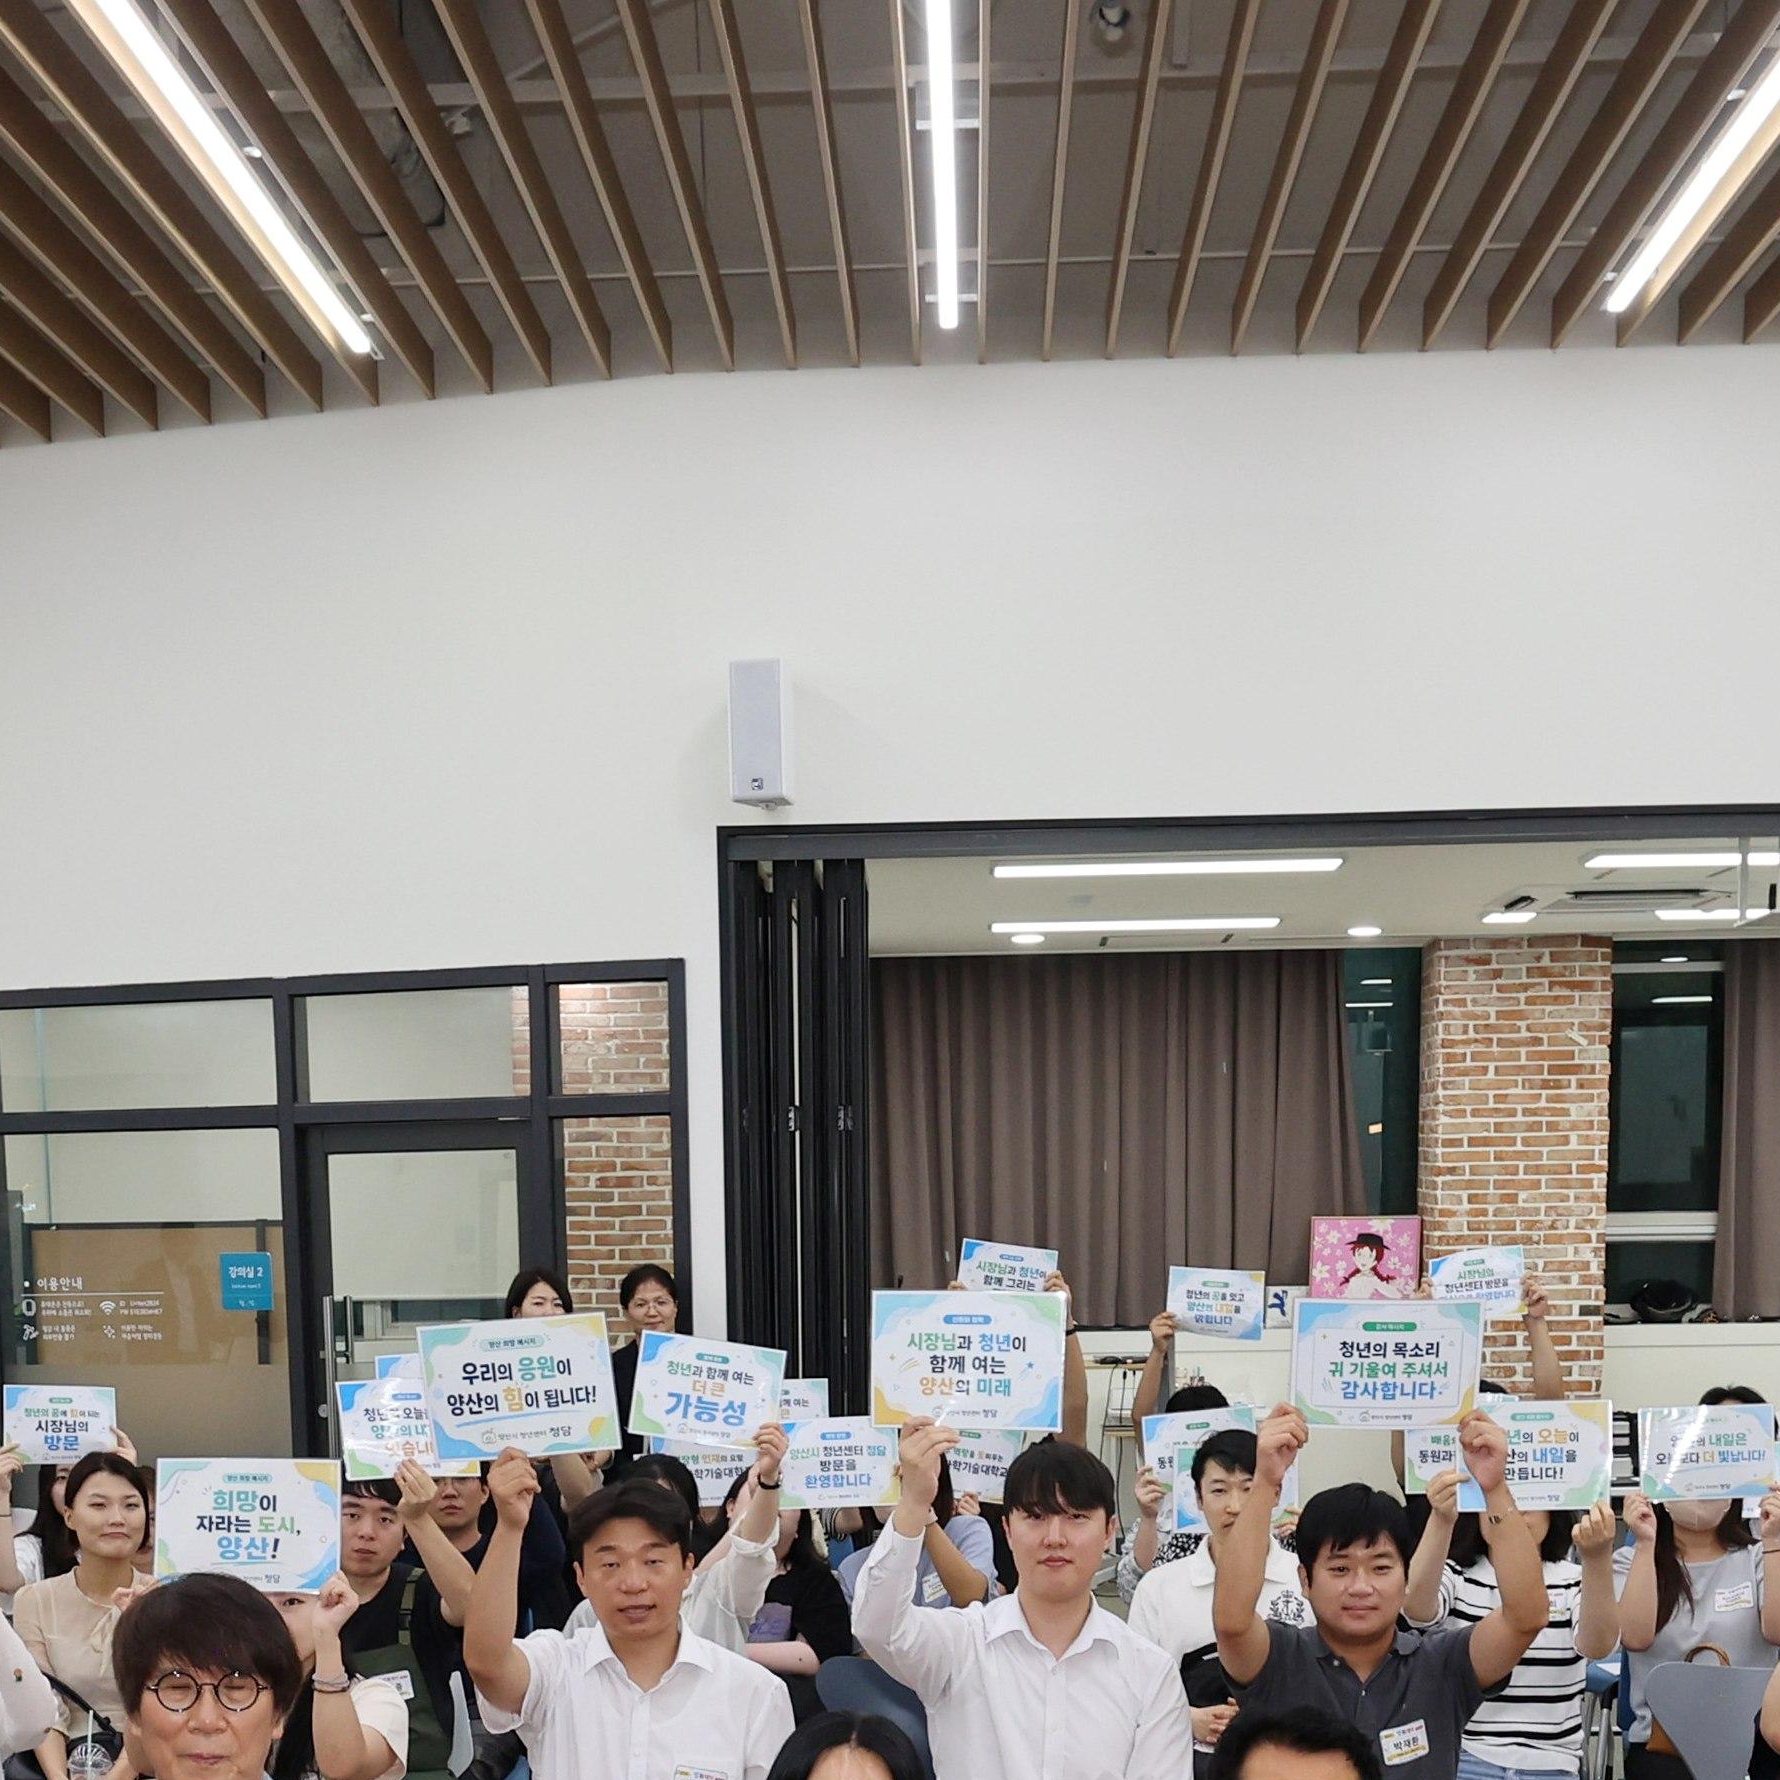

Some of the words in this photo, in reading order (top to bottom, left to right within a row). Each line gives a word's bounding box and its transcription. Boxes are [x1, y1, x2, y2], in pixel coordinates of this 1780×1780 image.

[228, 1266, 254, 1278] 강의실
[256, 1267, 264, 1277] 2
[36, 1276, 83, 1291] 이용안내
[908, 1332, 973, 1353] 시장님과
[978, 1333, 1027, 1352] 청년이
[1339, 1340, 1388, 1360] 청년의
[1392, 1340, 1440, 1359] 목소리
[461, 1360, 514, 1384] 우리의
[518, 1357, 573, 1380] 응원이
[665, 1360, 703, 1380] 청년과
[705, 1365, 731, 1382] 함께
[732, 1369, 755, 1387] 여는
[929, 1354, 965, 1375] 함께
[971, 1354, 1007, 1374] 여는
[1328, 1361, 1345, 1378] 귀
[1348, 1360, 1398, 1379] 기울여
[1401, 1361, 1448, 1379] 주셔서
[692, 1380, 709, 1394] 더
[710, 1382, 726, 1397] 큰
[919, 1375, 971, 1397] 양산의
[976, 1376, 1012, 1397] 미래
[1340, 1379, 1437, 1401] 감사합니다
[447, 1392, 500, 1418] 양산의
[502, 1385, 541, 1410] 힘이
[545, 1385, 597, 1410] 됩니다!
[664, 1391, 747, 1427] 가능성
[35, 1420, 89, 1433] 시장님의
[44, 1435, 80, 1451] 방문
[1538, 1429, 1579, 1444] 오늘이
[1709, 1433, 1746, 1446] 내일은
[823, 1446, 864, 1457] 청년센터
[1533, 1447, 1577, 1464] 내일을
[1718, 1450, 1766, 1463] 빛납니다!
[820, 1459, 857, 1472] 방문을
[805, 1473, 871, 1489] 환영합니다
[212, 1489, 278, 1513] 희망이
[196, 1513, 252, 1534] 자라는
[257, 1516, 301, 1536] 도시,
[217, 1536, 280, 1562] 양산!
